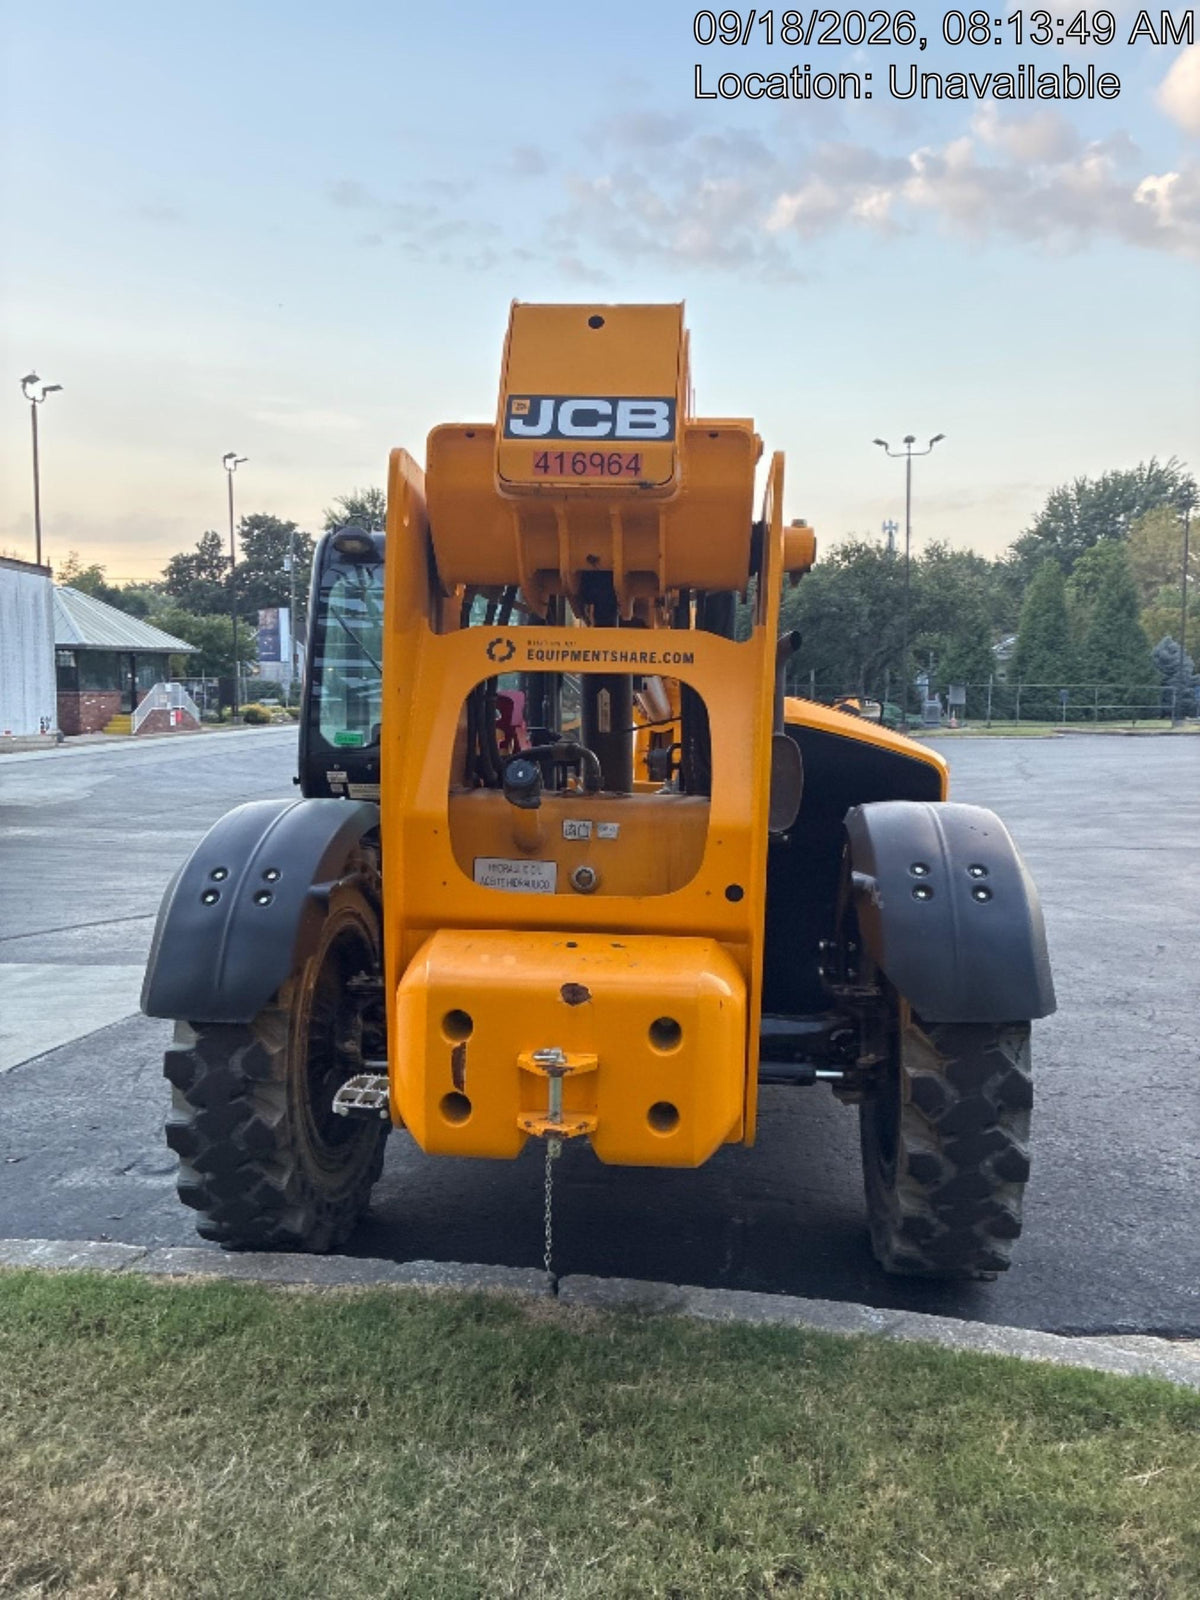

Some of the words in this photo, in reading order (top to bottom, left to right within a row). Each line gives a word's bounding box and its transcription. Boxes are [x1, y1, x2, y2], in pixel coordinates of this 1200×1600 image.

[509, 399, 670, 438] JCB
[534, 451, 641, 476] 416964
[527, 649, 694, 664] EQUIPMENTSHARE.COM
